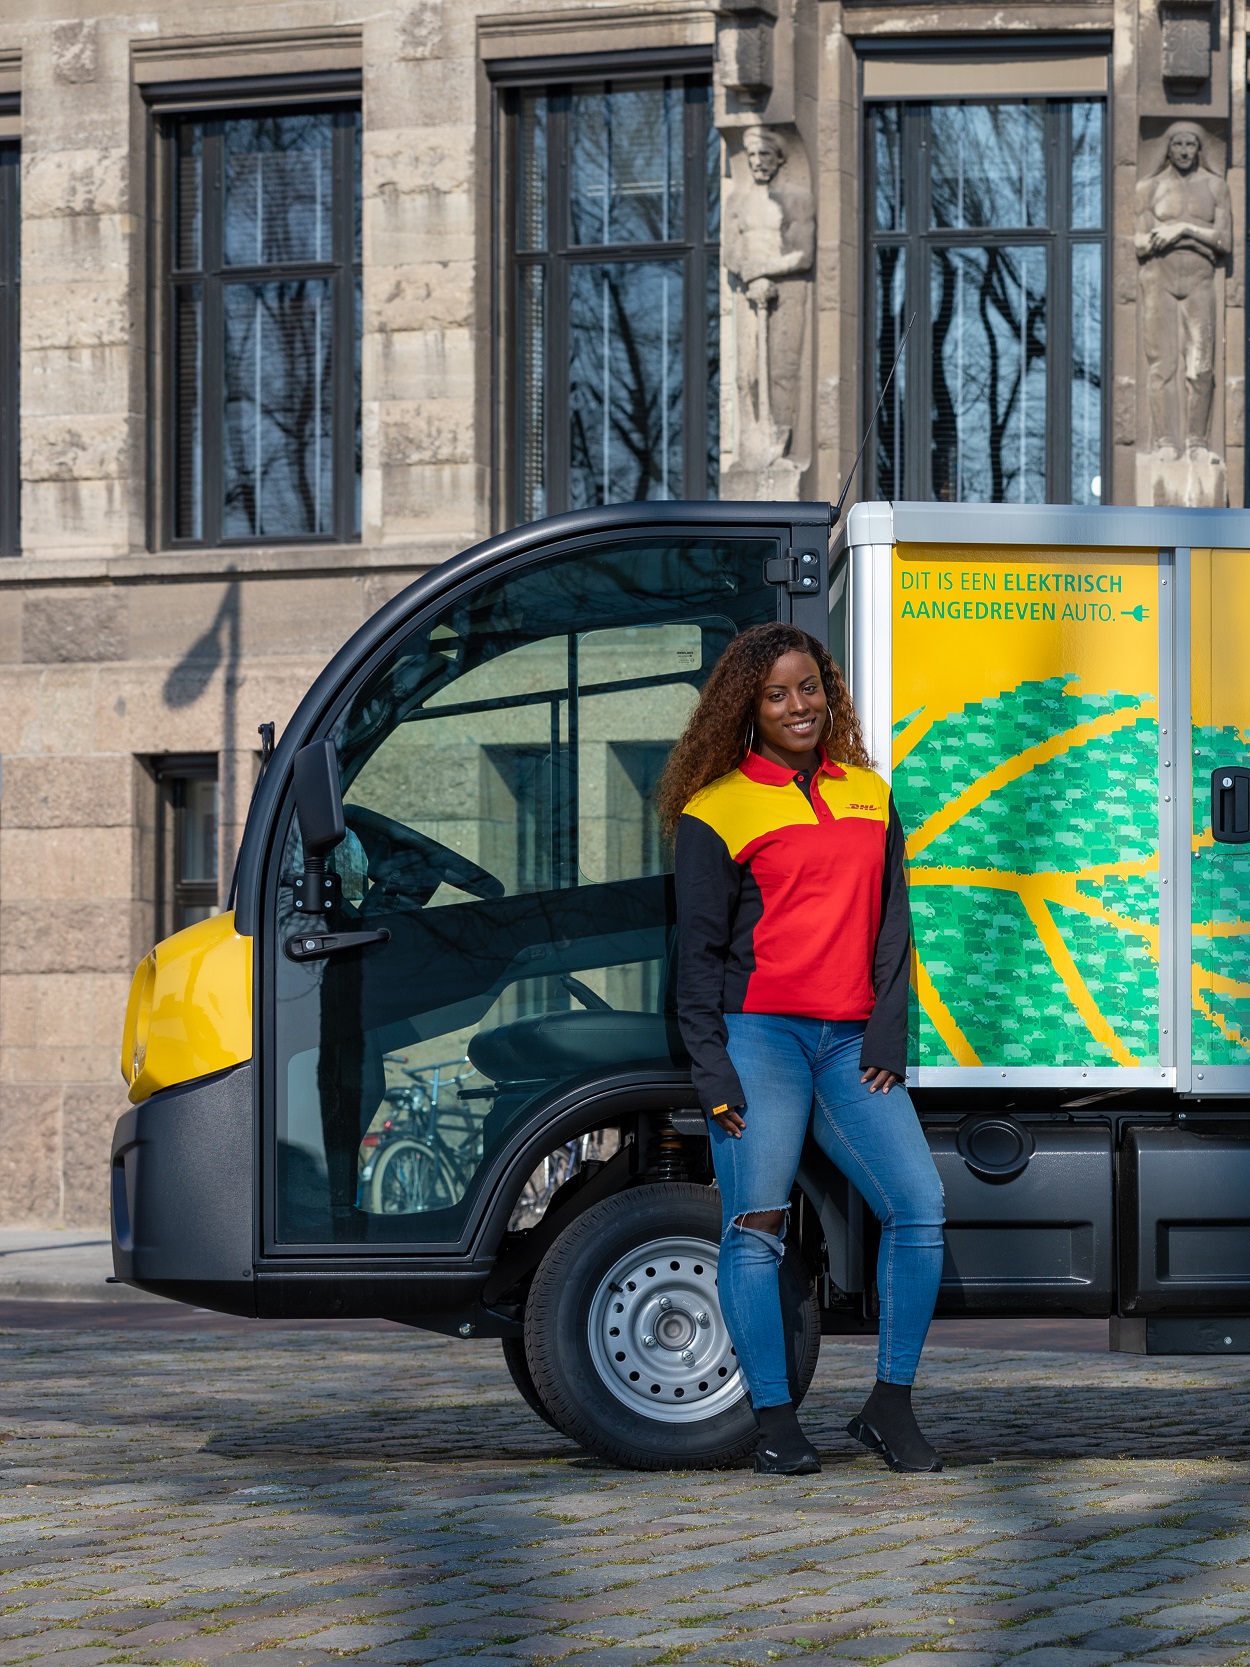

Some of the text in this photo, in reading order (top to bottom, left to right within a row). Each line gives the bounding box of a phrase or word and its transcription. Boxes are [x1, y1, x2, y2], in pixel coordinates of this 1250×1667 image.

[901, 571, 1123, 593] DIT IS EEN ELEKTRISCH
[901, 600, 1116, 622] AANGEDREVEN AUTO.
[849, 803, 878, 811] DHL
